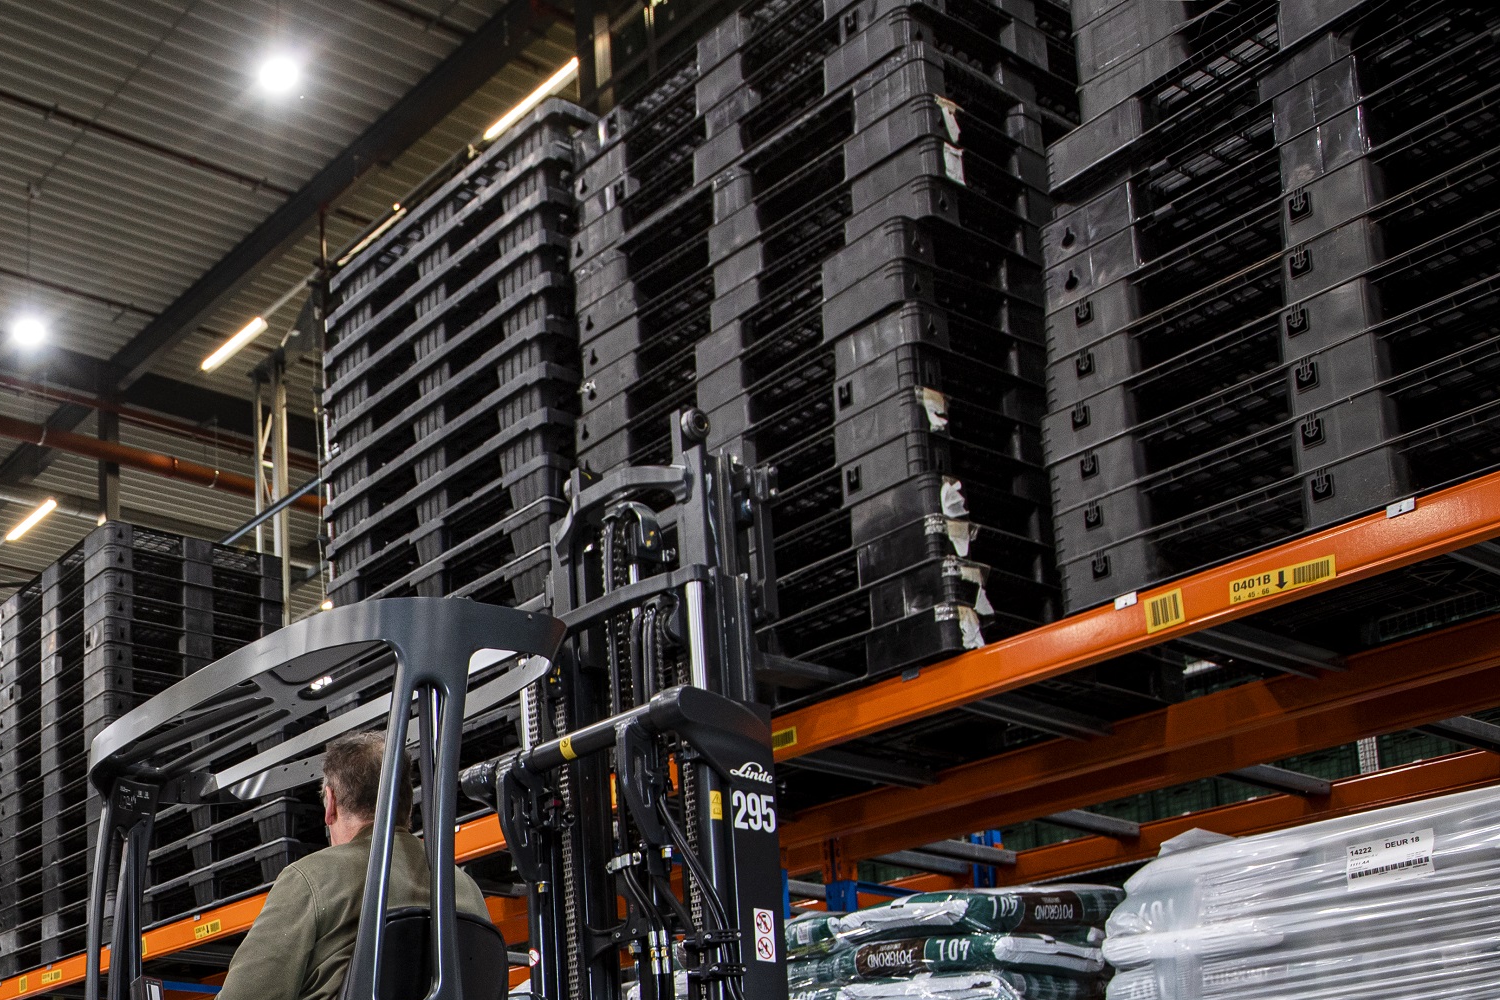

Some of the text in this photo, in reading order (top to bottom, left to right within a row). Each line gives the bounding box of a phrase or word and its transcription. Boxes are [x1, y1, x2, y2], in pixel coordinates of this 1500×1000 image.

[1233, 574, 1271, 593] 0401B
[730, 762, 773, 783] Linde
[732, 790, 776, 833] 295
[1350, 847, 1372, 856] 14222
[1385, 839, 1408, 849] DEUR
[1035, 904, 1074, 920] POTGROND
[867, 950, 913, 969] POTGROND
